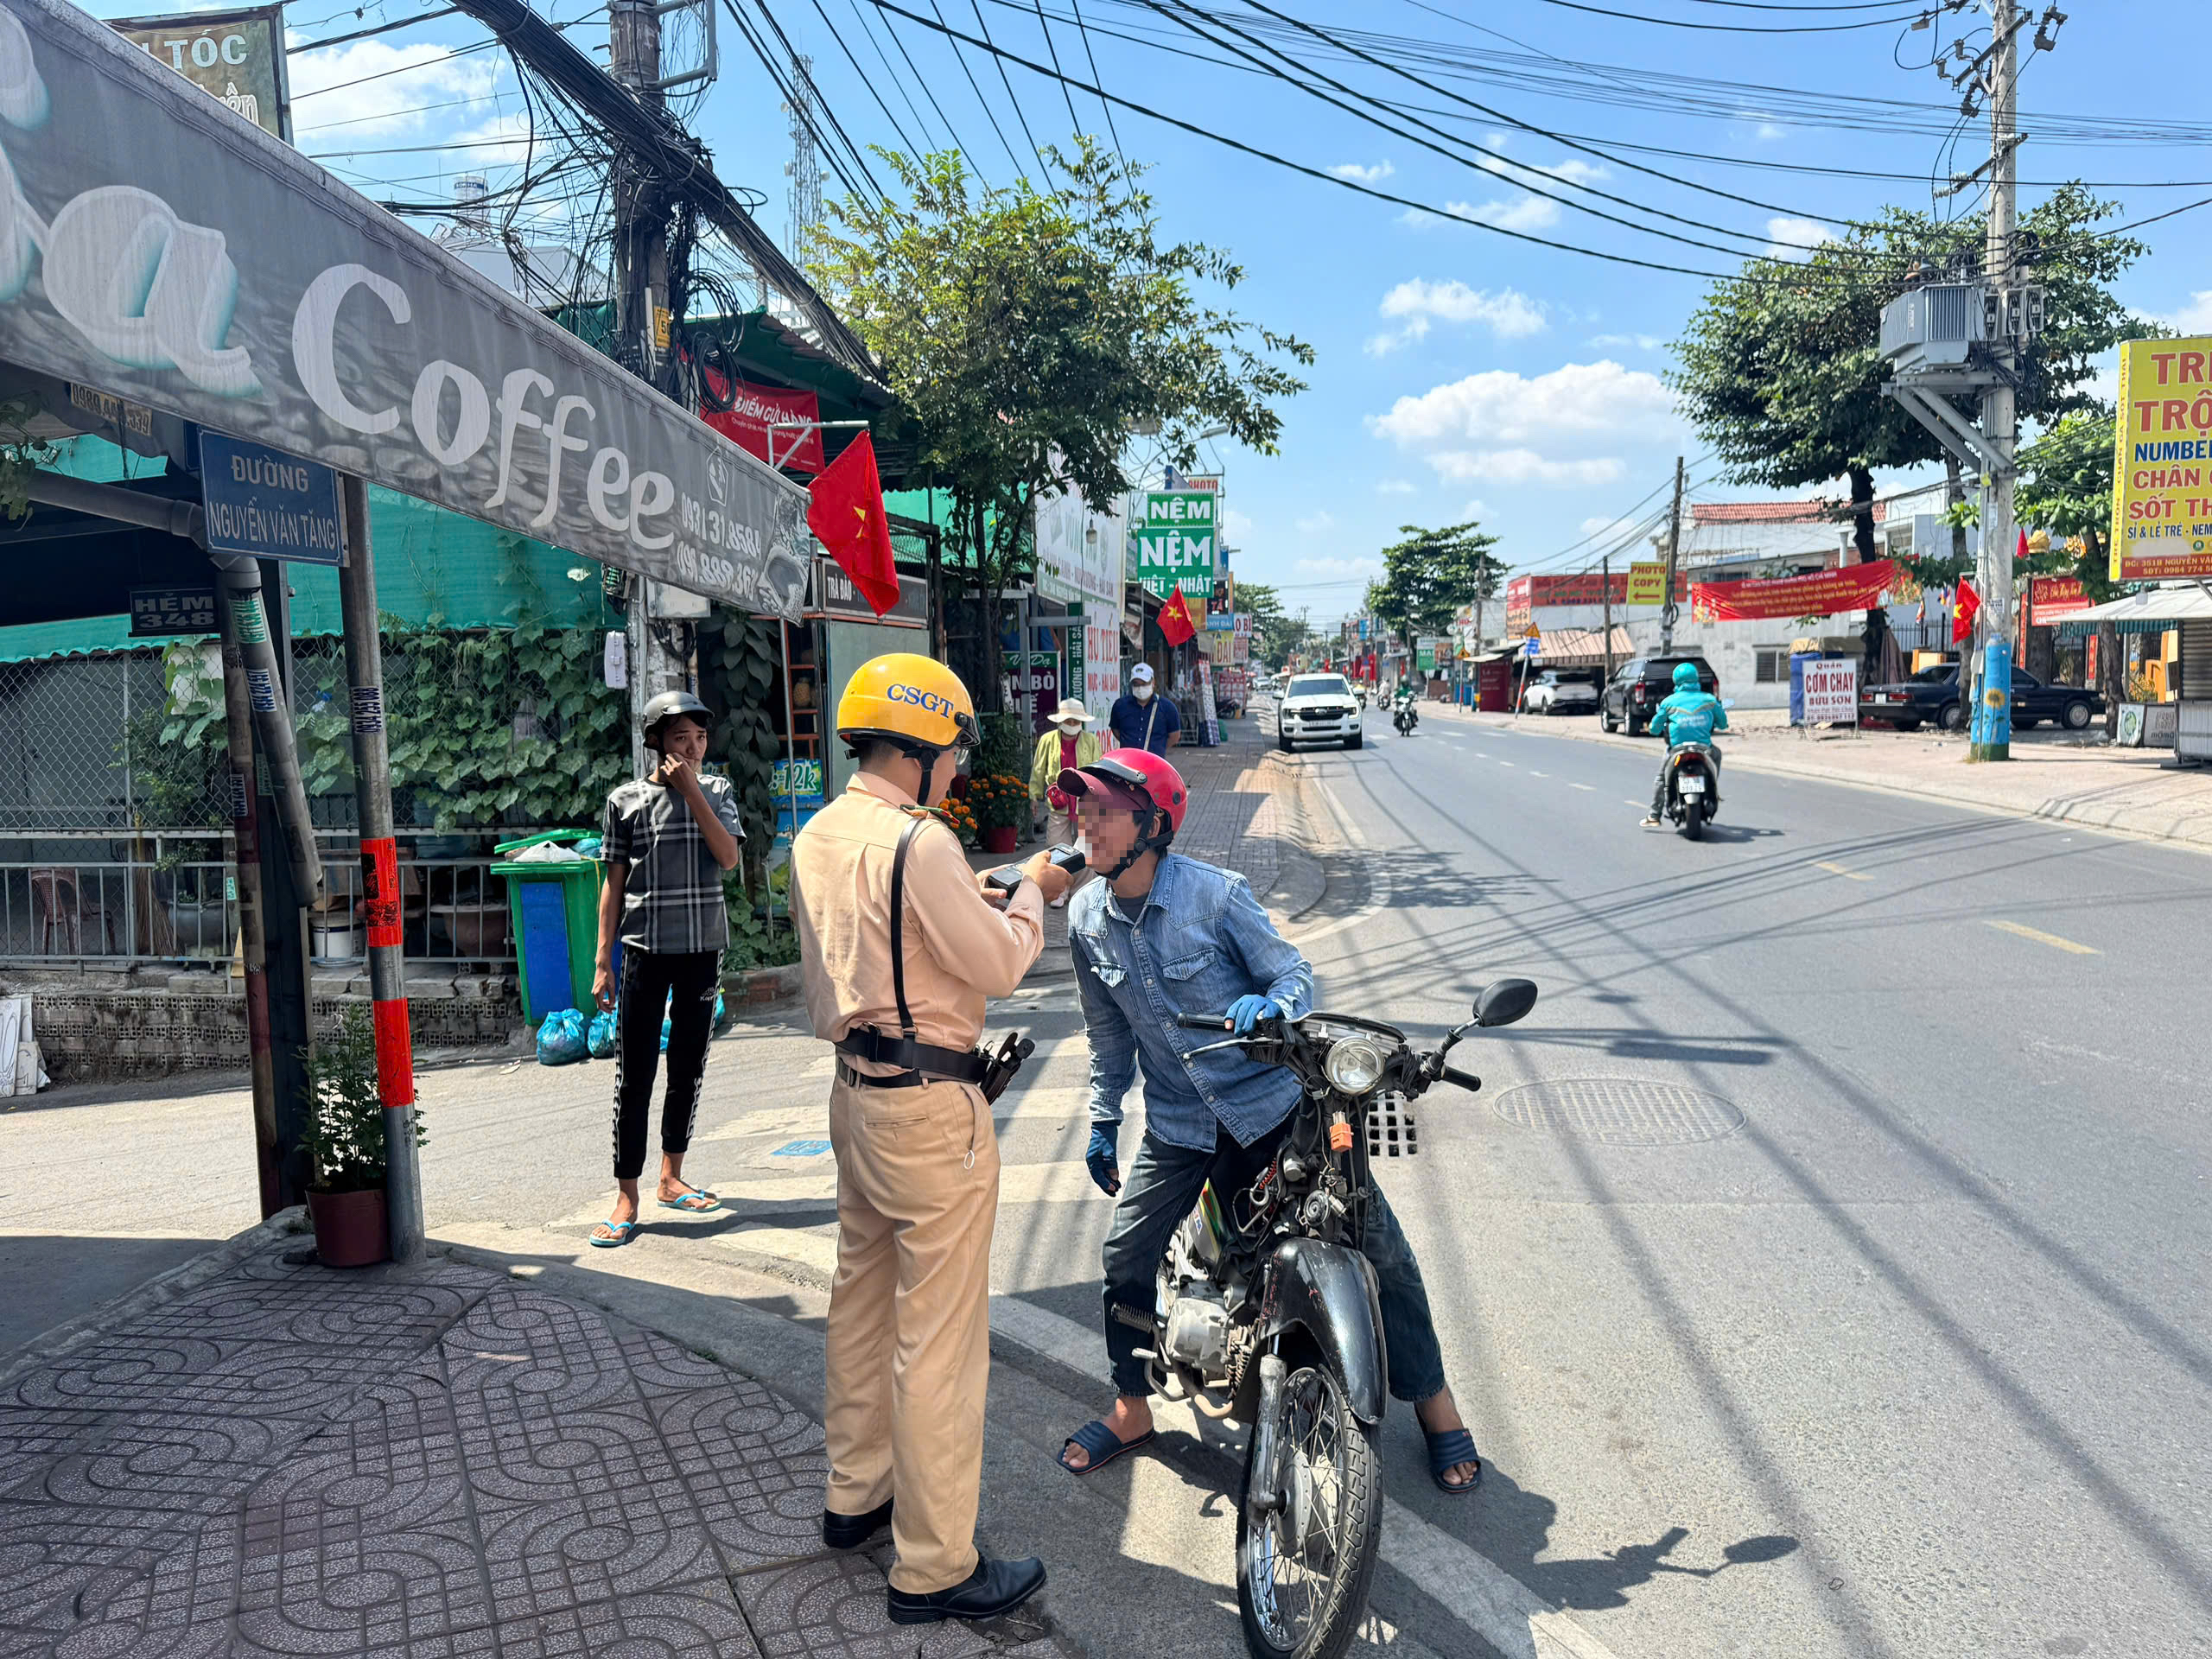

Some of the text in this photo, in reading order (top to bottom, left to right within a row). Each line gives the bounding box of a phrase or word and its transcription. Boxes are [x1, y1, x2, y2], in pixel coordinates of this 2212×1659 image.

[164, 29, 248, 70] TÓC
[2151, 352, 2212, 385] TR
[73, 383, 150, 434] 0989.44.339
[291, 263, 675, 550] Coffee
[735, 395, 764, 418] ĐIỂM
[2134, 442, 2212, 463] NUMBE
[231, 454, 309, 493] ĐƯỜNG
[2133, 464, 2200, 489] CHÂN
[1150, 495, 1211, 524] NỆM
[2128, 493, 2177, 520] SỐT
[209, 496, 336, 550] NGUYỄN VĂN TĂNG
[2139, 525, 2147, 538] &
[1139, 530, 1211, 574] NỆM
[1630, 565, 1667, 575] PHOTO
[827, 573, 852, 601] TRÀ ĐÀO
[1177, 574, 1211, 596] NHẬT
[1633, 579, 1661, 588] COPY
[138, 611, 215, 628] 348
[1069, 625, 1082, 639] SẢ
[1032, 671, 1055, 690] BÒ
[1806, 671, 1854, 693] CƠM CHAY
[887, 683, 955, 719] CSGT
[783, 764, 817, 790] 12k
